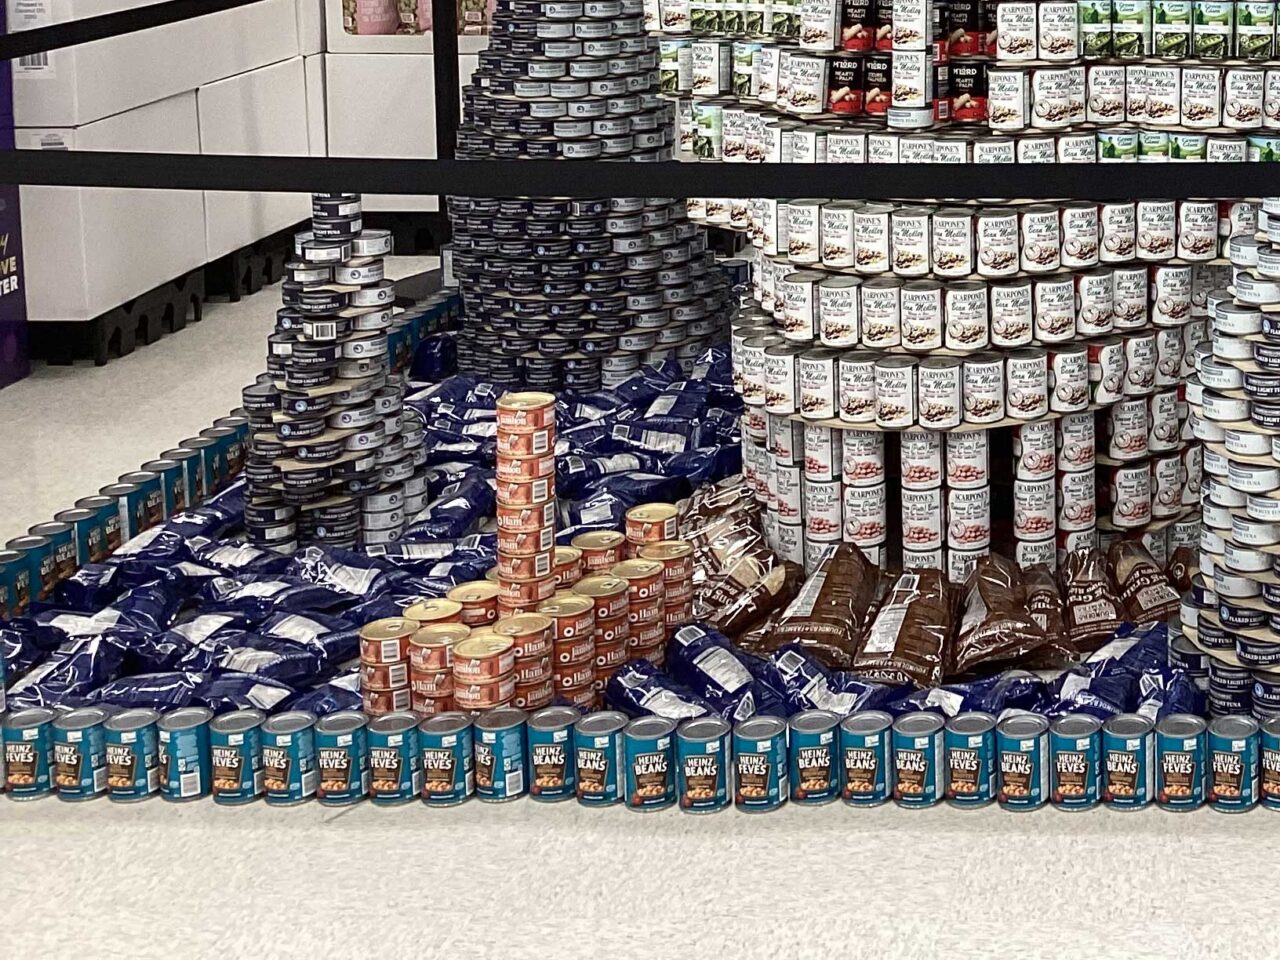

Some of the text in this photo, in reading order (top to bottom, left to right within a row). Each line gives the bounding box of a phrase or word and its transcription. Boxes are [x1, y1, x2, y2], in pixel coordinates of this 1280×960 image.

[6, 744, 31, 755] HEINZ
[320, 749, 346, 760] HEINZ
[535, 745, 561, 756] HEINZ
[5, 753, 34, 764] FEVES
[319, 758, 348, 769] FEVES
[533, 754, 565, 766] BEANS
[638, 754, 664, 765] HEINZ
[739, 755, 764, 766] HEINZ
[1058, 753, 1084, 764] HEINZ
[635, 762, 668, 775] BEANS
[738, 764, 767, 775] FEVES
[1057, 762, 1086, 774] FEVES
